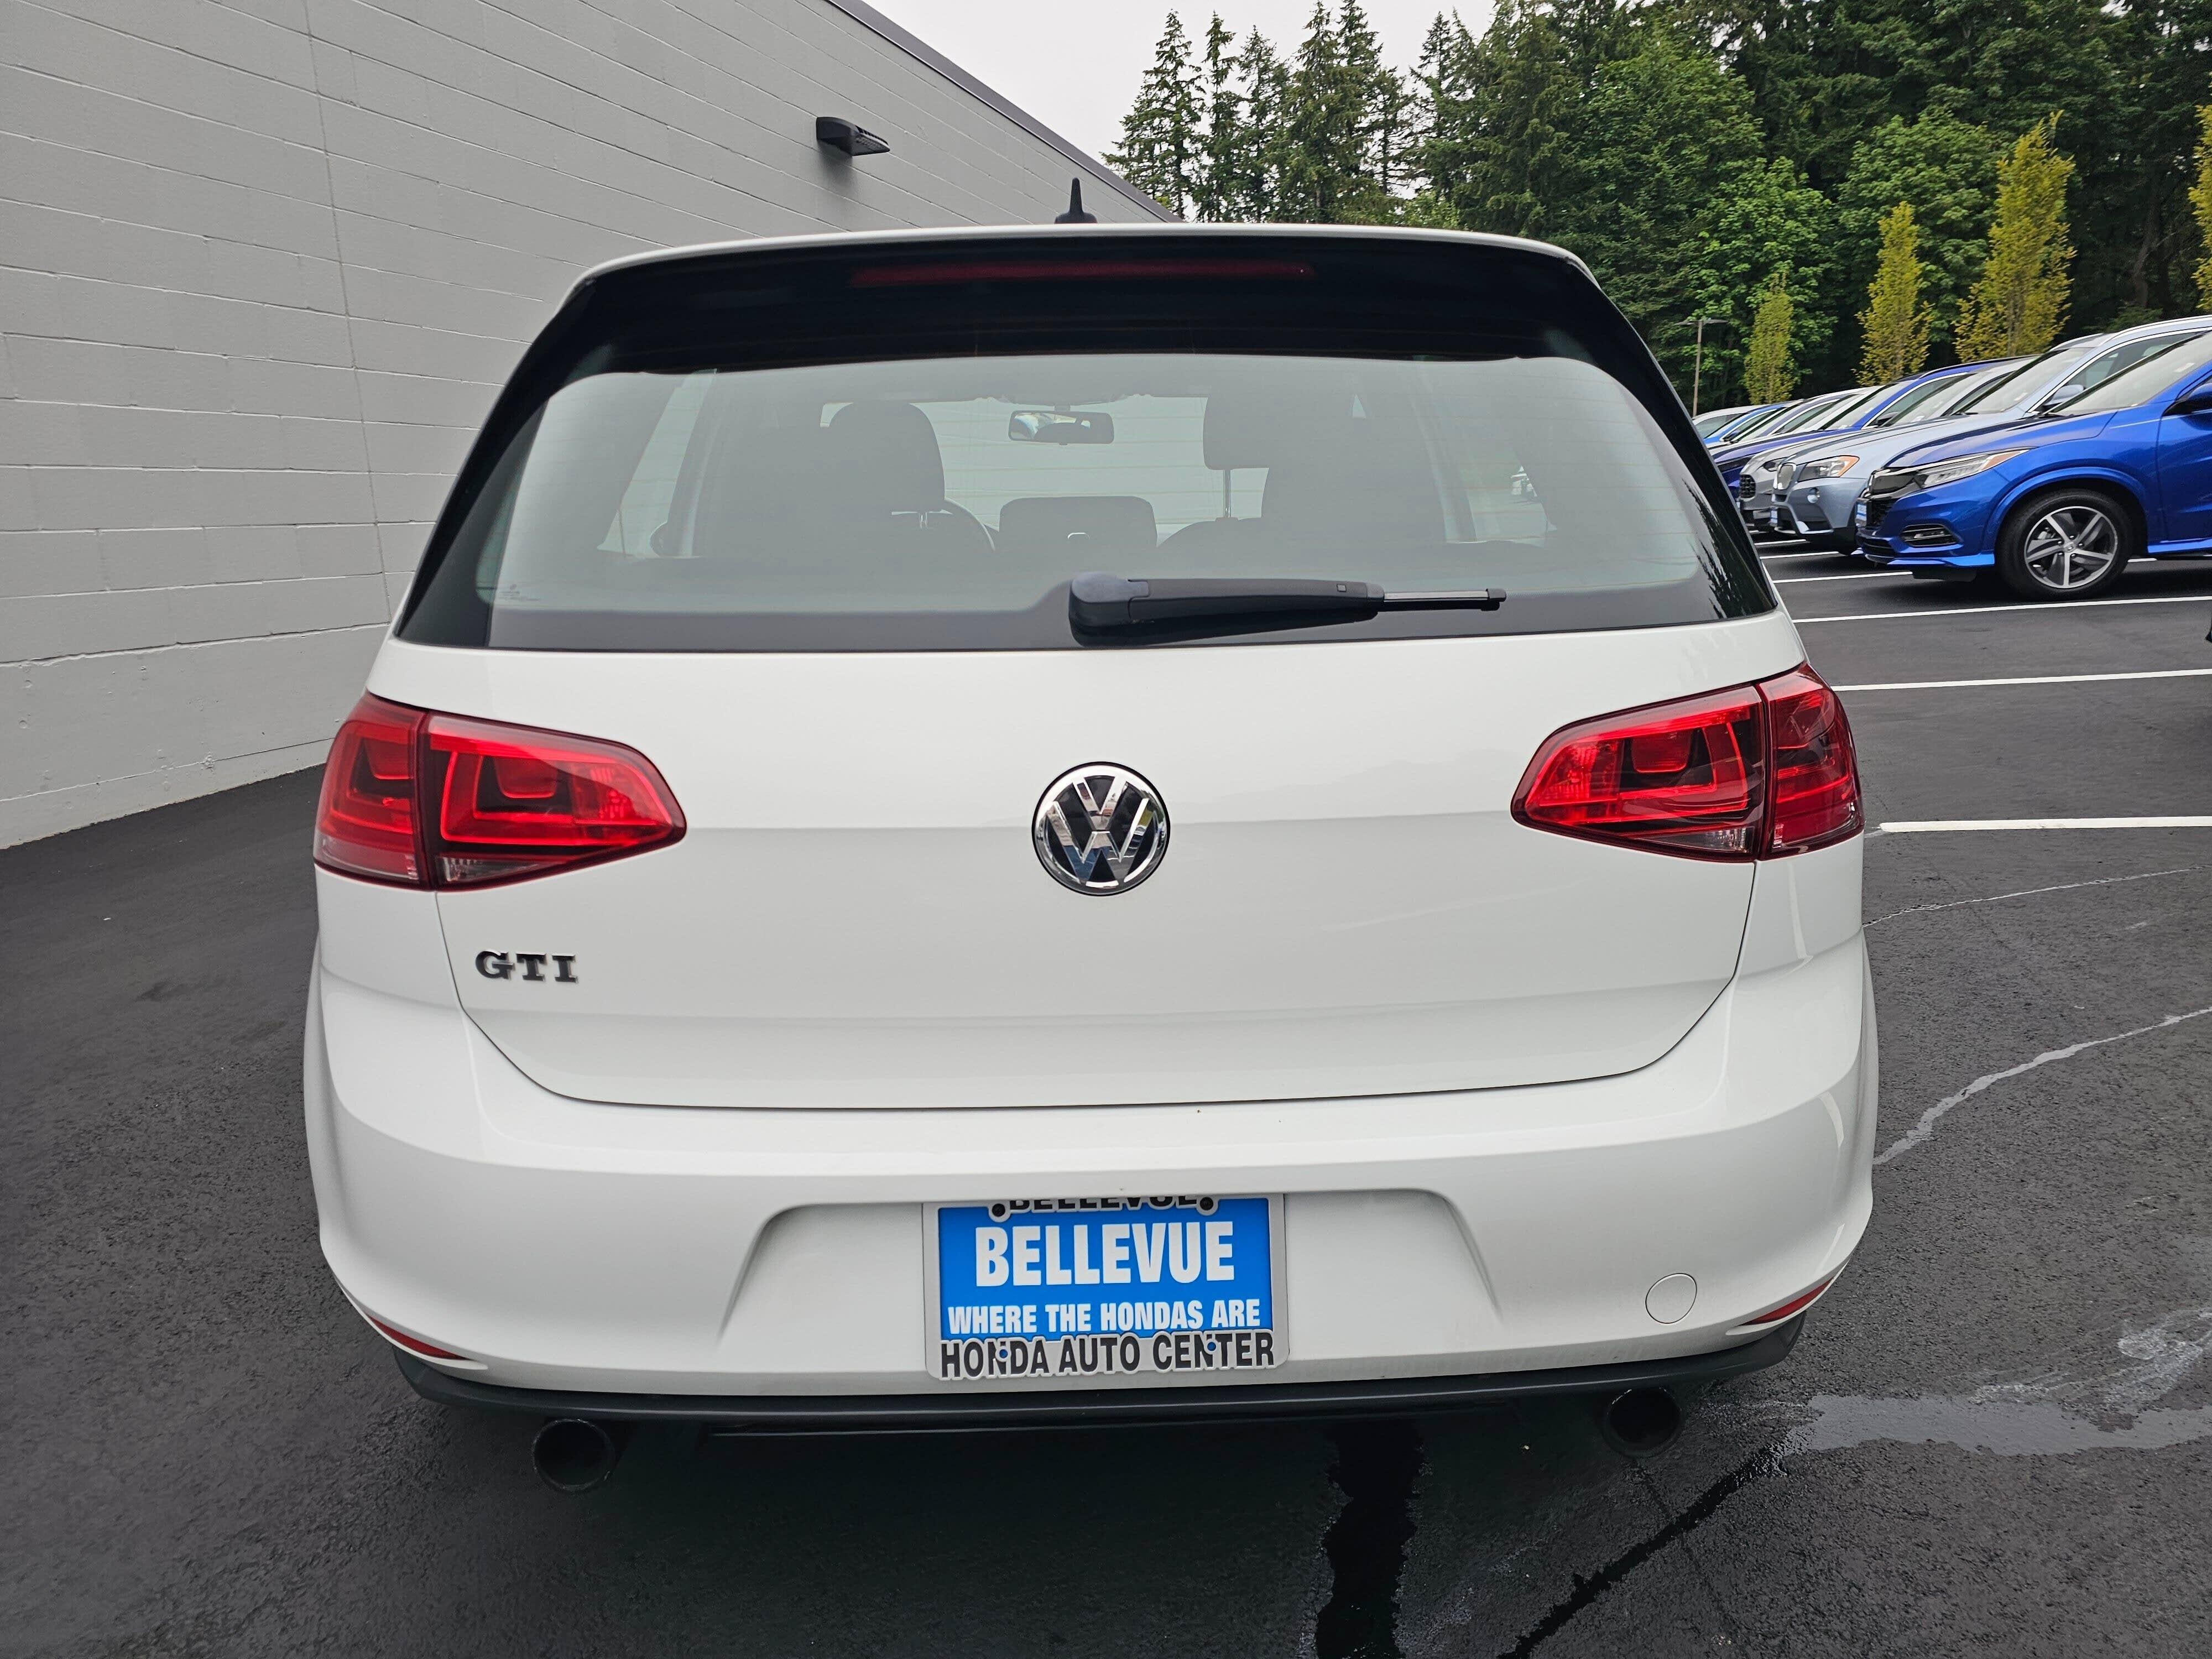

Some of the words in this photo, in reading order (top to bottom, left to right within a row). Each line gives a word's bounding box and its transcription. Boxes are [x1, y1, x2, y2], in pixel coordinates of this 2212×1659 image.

[475, 950, 578, 983] GTI
[975, 1221, 1235, 1287] BELLEVUE
[948, 1305, 1037, 1334] WHERE
[1045, 1304, 1091, 1332] THE
[1100, 1300, 1204, 1331] HONDAS
[1211, 1299, 1260, 1327] ARE
[941, 1337, 1050, 1378] HONDA
[1058, 1334, 1141, 1372] AUTO
[1152, 1332, 1274, 1371] CENTER
